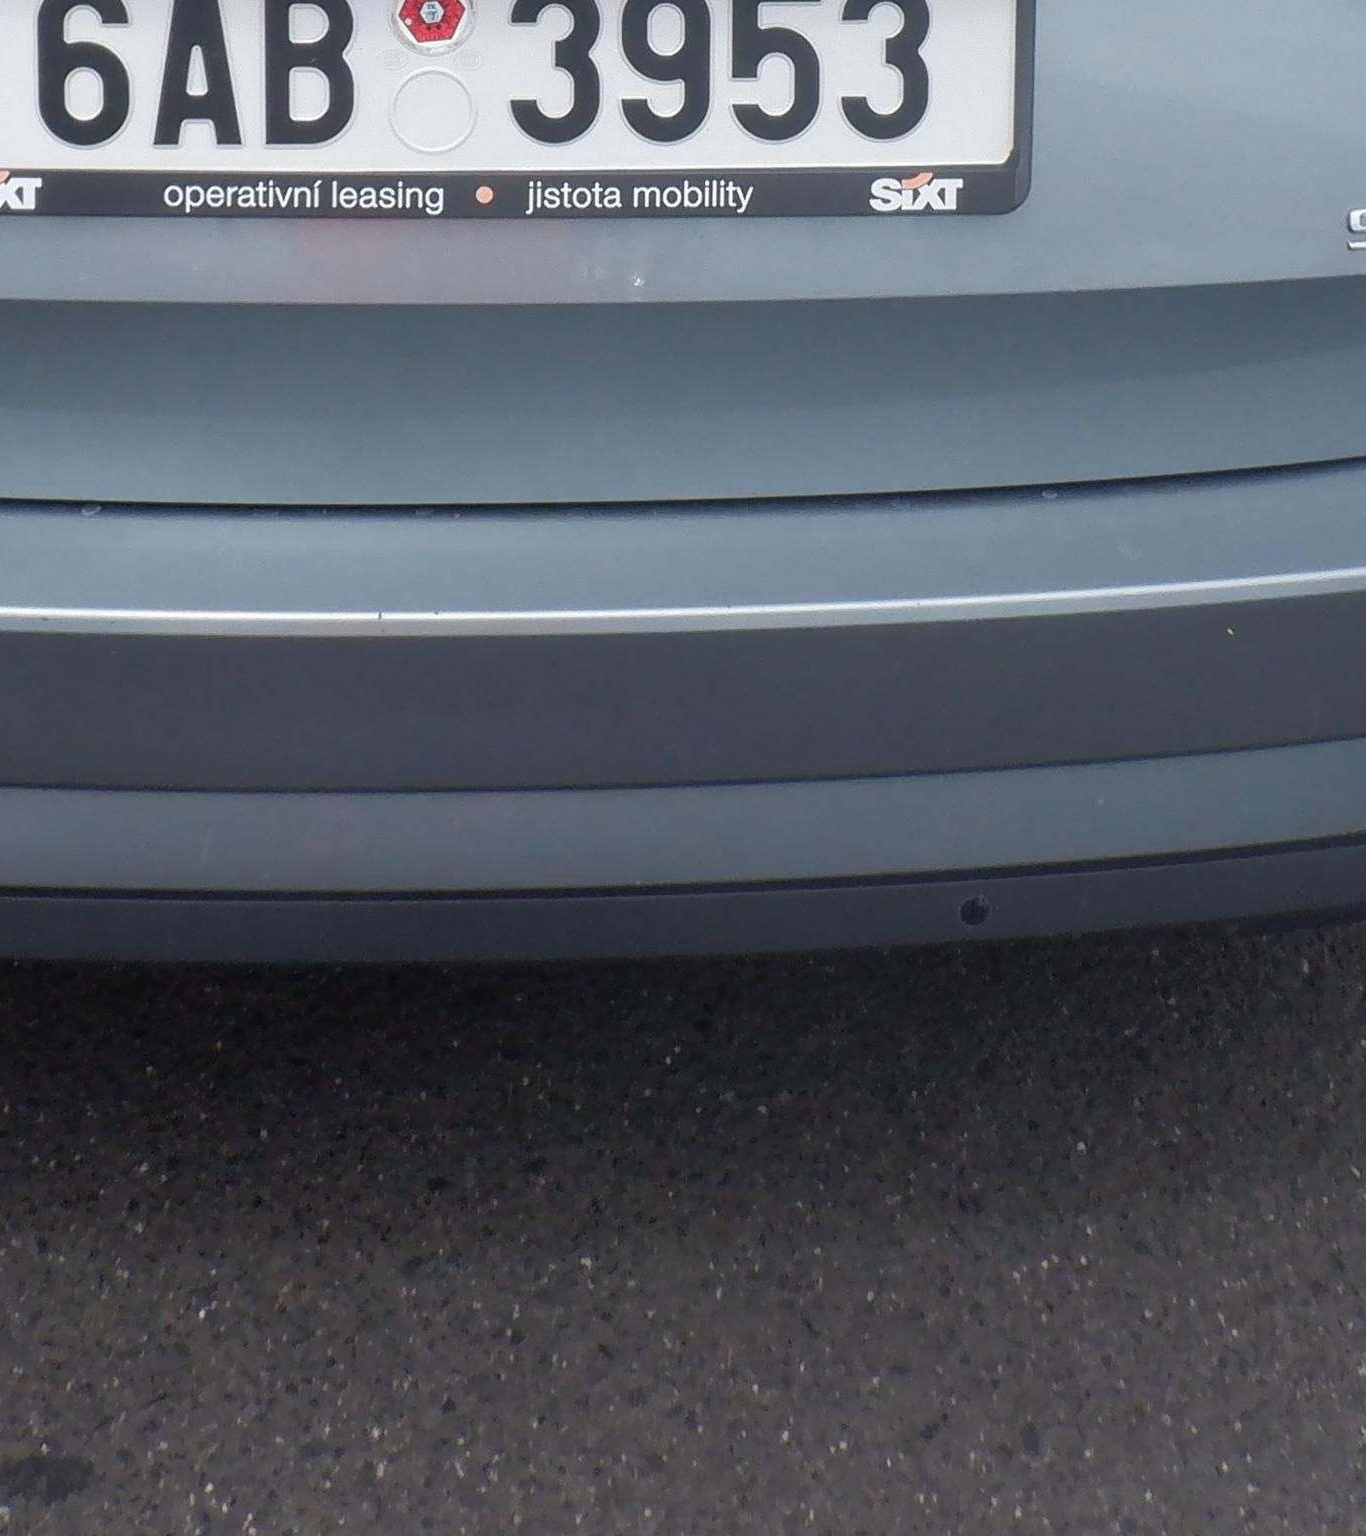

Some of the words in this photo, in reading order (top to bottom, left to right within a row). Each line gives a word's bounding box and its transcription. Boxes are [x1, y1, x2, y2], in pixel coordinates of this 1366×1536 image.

[163, 180, 322, 213] operativní
[332, 181, 444, 215] leasing
[525, 181, 622, 214] jistota
[634, 180, 754, 213] mobility
